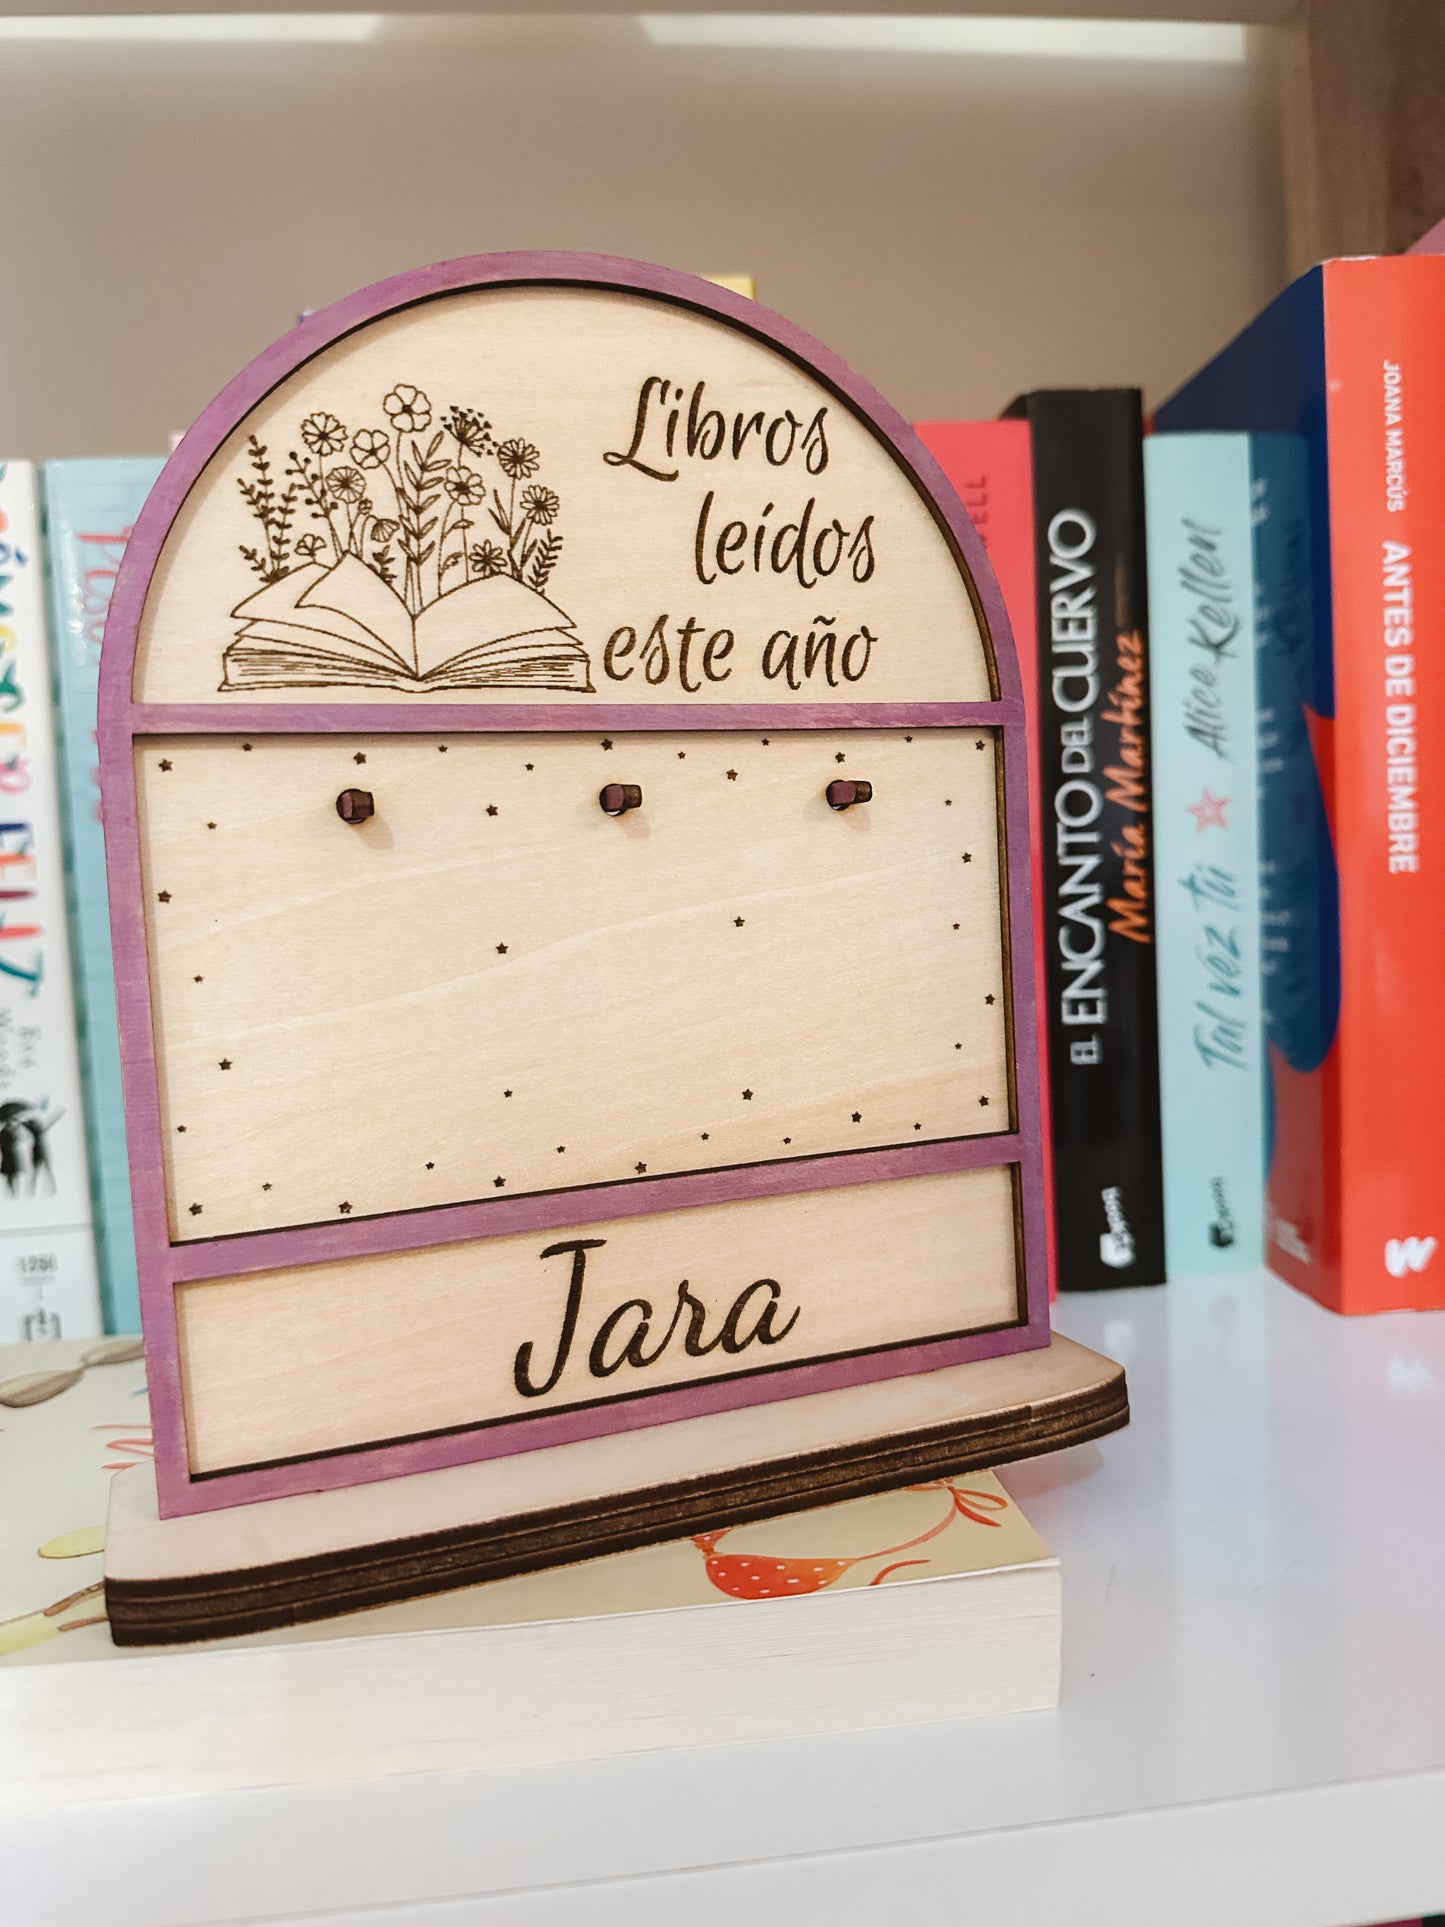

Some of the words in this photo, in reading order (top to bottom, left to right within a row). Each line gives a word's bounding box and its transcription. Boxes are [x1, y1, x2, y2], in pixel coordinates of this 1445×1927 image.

[603, 376, 829, 482] Libros
[1383, 358, 1403, 427] JOANA
[1385, 428, 1409, 513] MARCÚS
[695, 490, 875, 589] leídos
[1176, 515, 1241, 660] Kellen
[1046, 506, 1099, 713] CUERVO
[1382, 539, 1413, 648] ANTES
[603, 613, 735, 692] este
[761, 615, 878, 690] año
[1384, 653, 1416, 697] DE
[1060, 713, 1096, 774] DEL
[1101, 628, 1147, 813] Martínez
[1181, 664, 1237, 766] Alice
[1385, 703, 1420, 875] DICIEMBRE
[1054, 779, 1108, 1025] ENCANTO
[1105, 823, 1151, 944] María
[1197, 920, 1243, 998] vez
[1069, 1034, 1103, 1066] EL
[1192, 998, 1250, 1072] Tal
[514, 1239, 801, 1397] Jara
